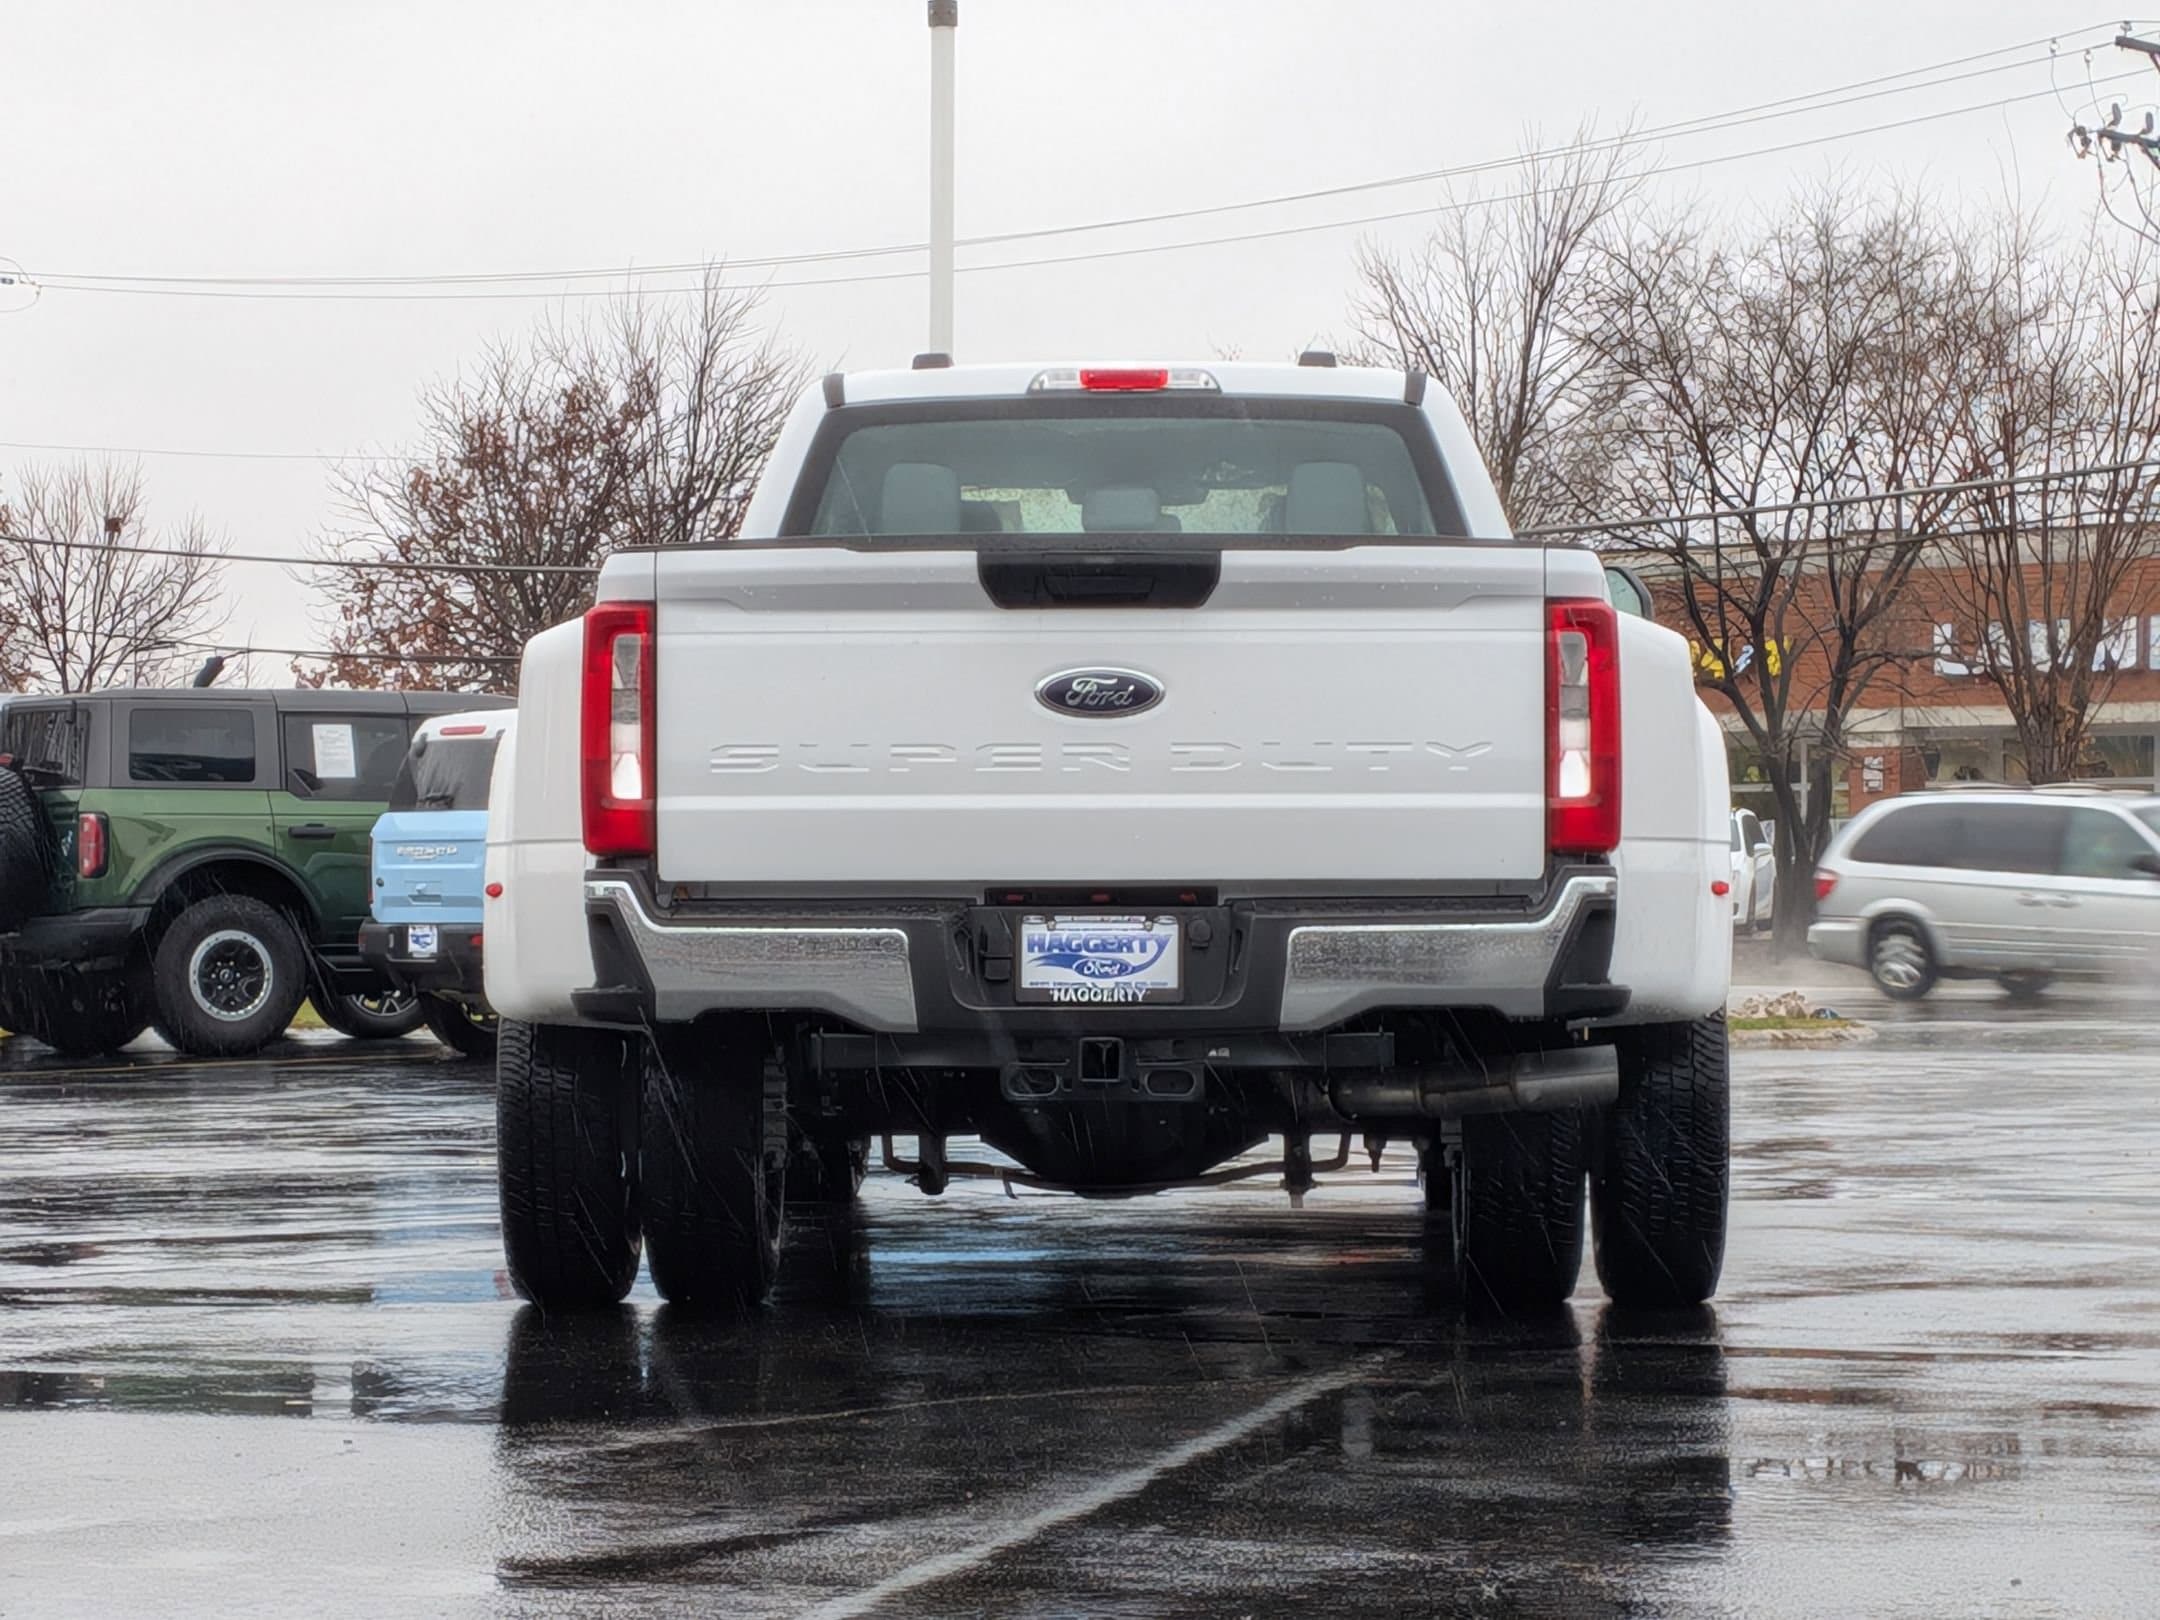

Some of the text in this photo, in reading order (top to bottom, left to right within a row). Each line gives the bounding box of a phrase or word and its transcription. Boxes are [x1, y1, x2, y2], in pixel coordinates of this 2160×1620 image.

[1065, 677, 1135, 706] Ford
[710, 741, 1493, 773] SUPER DUTY
[1027, 934, 1173, 953] HAGGERTY
[1083, 959, 1121, 976] Ford
